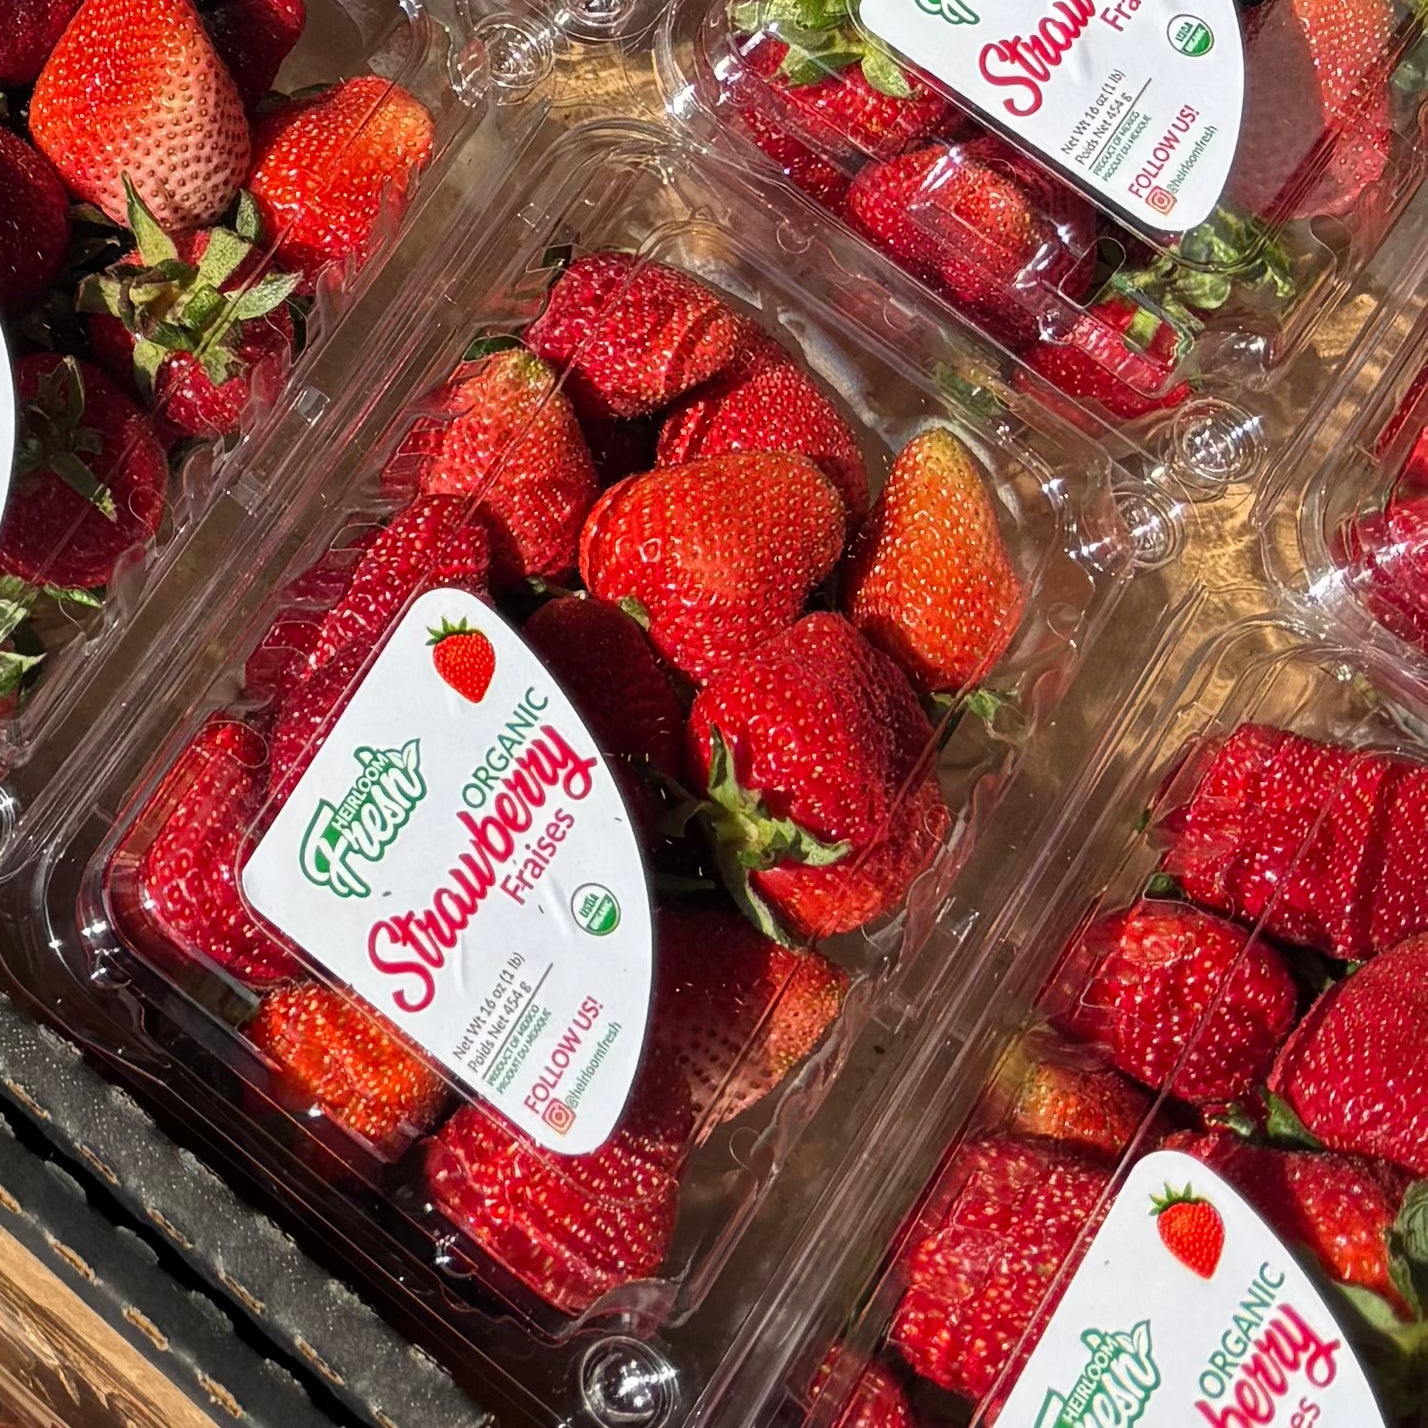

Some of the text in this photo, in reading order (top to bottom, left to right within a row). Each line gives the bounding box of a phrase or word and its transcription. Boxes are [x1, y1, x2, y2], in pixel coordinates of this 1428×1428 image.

[330, 751, 389, 830] HEIRLOOM
[463, 687, 548, 807] ORGANIC
[300, 745, 428, 900] Fresh
[367, 726, 596, 1013] Strawberry
[501, 808, 575, 905] Fraises
[451, 949, 528, 1062] Net Wt 16 oz (1 lb)
[465, 1038, 495, 1075] Poids
[487, 1013, 510, 1041] Net
[501, 987, 525, 1017] 454
[522, 993, 604, 1116] FOLLOW US!
[563, 1021, 622, 1108] @heirloomfresh
[1060, 1334, 1119, 1424] HEIRLOOM
[1199, 1261, 1284, 1397] ORGANIC
